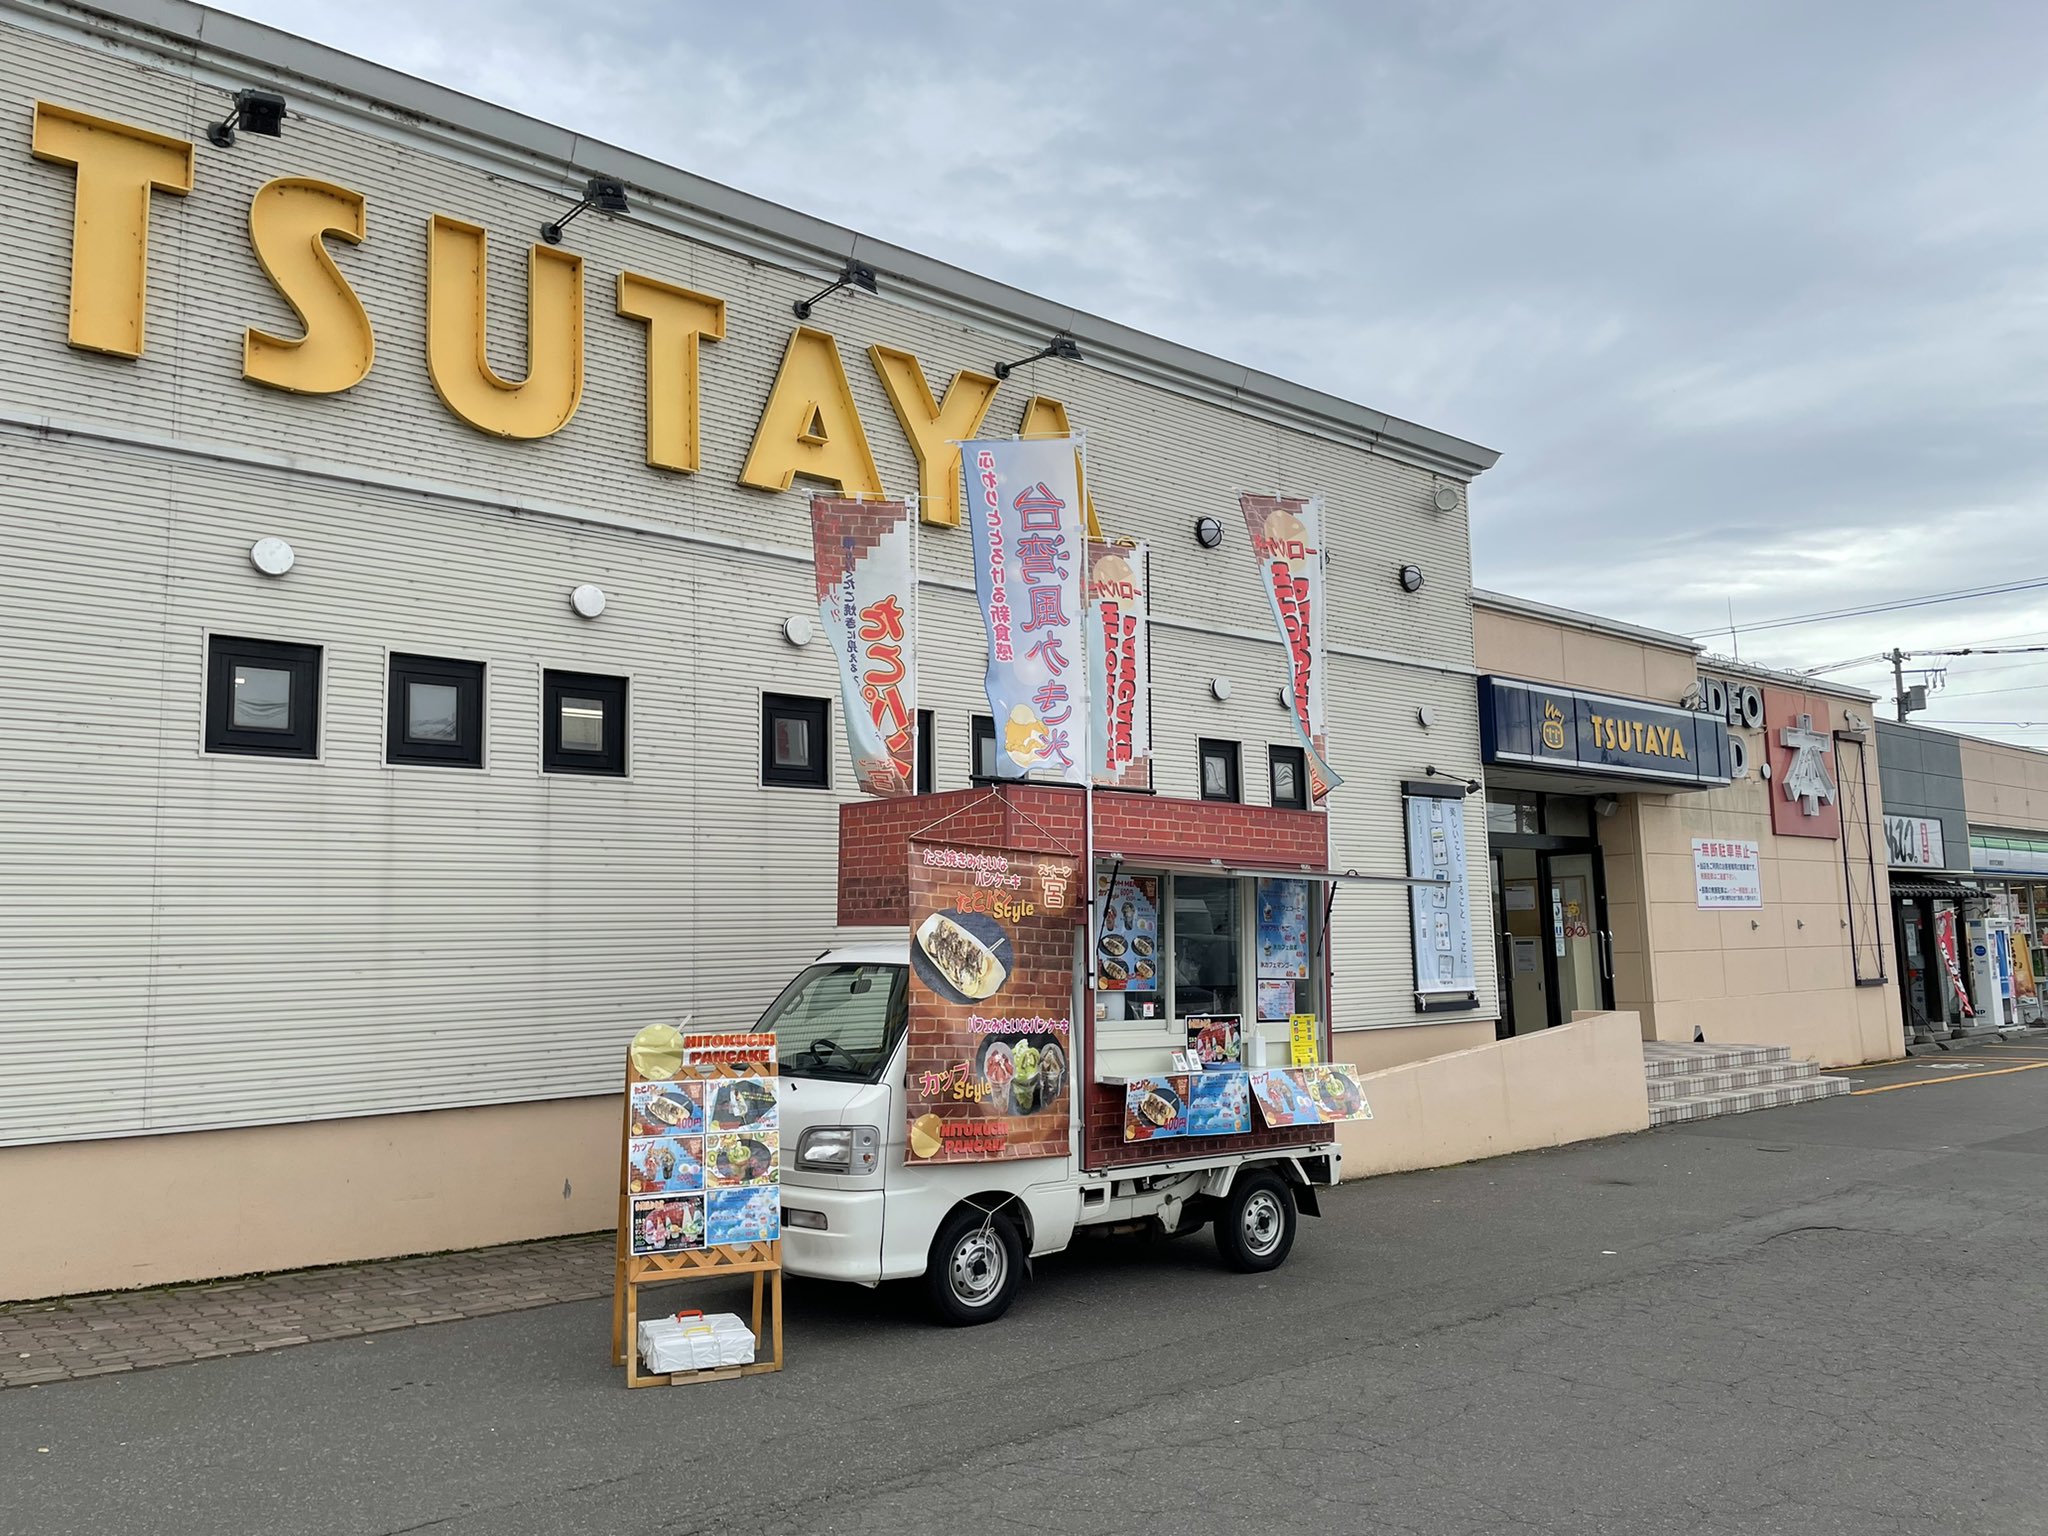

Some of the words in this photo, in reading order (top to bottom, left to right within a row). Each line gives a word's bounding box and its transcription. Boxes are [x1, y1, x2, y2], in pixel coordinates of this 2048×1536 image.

[1778, 712, 1836, 817] 本
[1701, 842, 1750, 859] 無断駐車禁止
[922, 848, 1008, 872] たこ焼きみたいな
[975, 871, 1021, 890] パンケーキ
[1041, 876, 1067, 909] 宮
[993, 899, 1035, 923] Style
[968, 1014, 1069, 1035] パフェみたいなパンケーキ
[684, 1034, 776, 1048] HITOKUCHI
[690, 1050, 770, 1064] PANCAKE
[919, 1059, 970, 1098] カップ
[953, 1077, 992, 1104] Style
[675, 1117, 702, 1129] 400円
[1163, 1117, 1187, 1130] 400円
[632, 1140, 656, 1152] カップ
[944, 1139, 1008, 1154] PANCAKE
